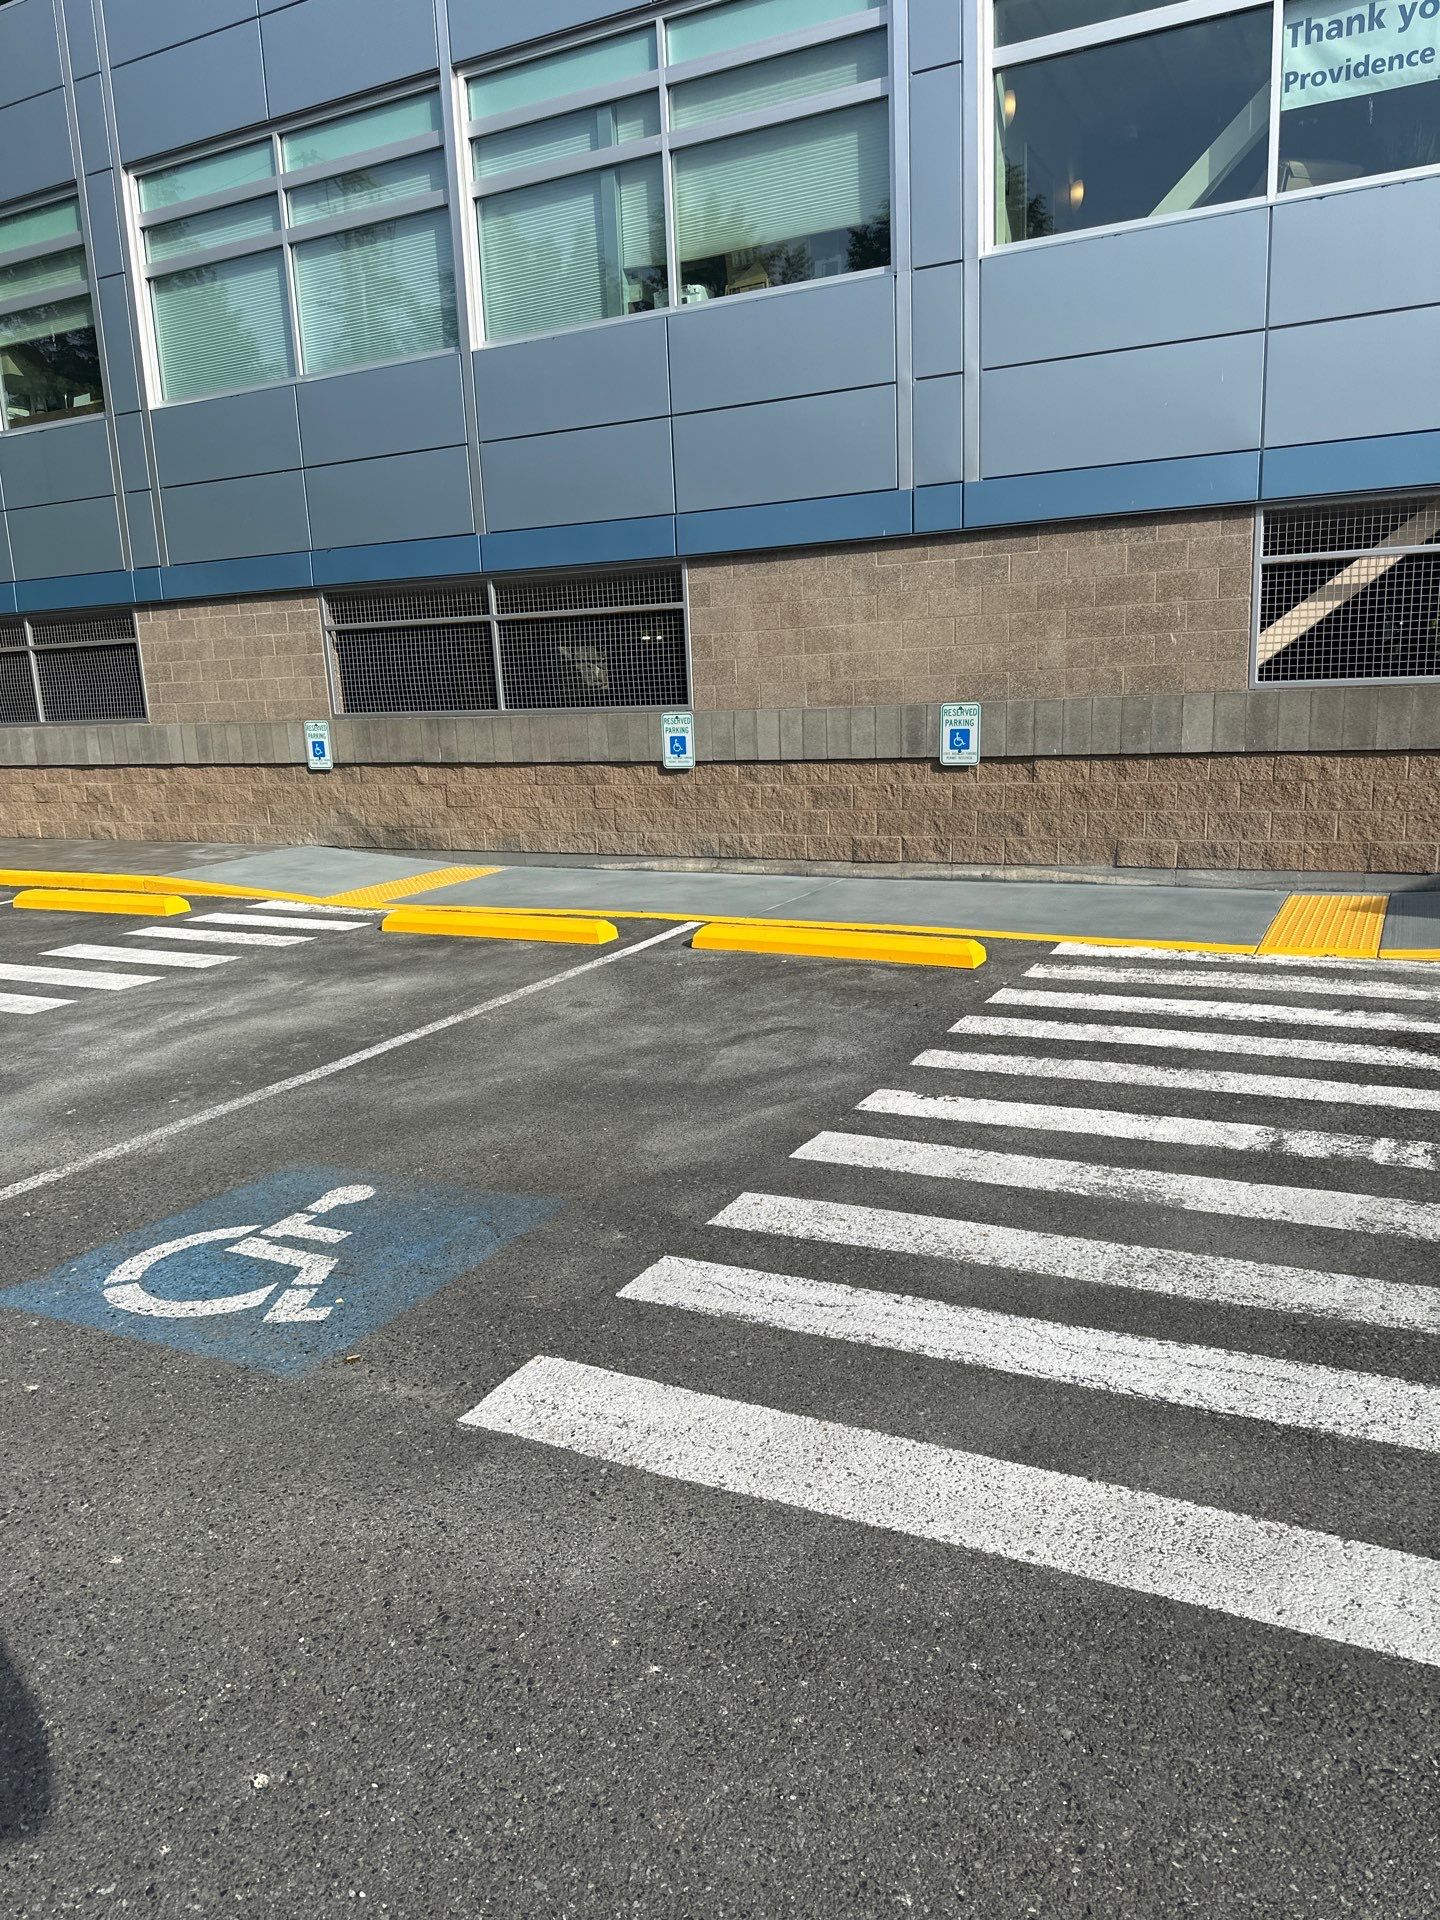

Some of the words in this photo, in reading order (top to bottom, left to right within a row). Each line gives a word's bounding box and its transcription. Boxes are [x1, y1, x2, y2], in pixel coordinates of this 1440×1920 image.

[1286, 2, 1387, 48] Thank
[1397, 0, 1440, 33] yo
[1284, 46, 1436, 93] Providence
[943, 708, 978, 717] RESERVED
[663, 717, 691, 725] RESERVED
[944, 719, 975, 727] PARKING
[665, 726, 689, 734] PARKING
